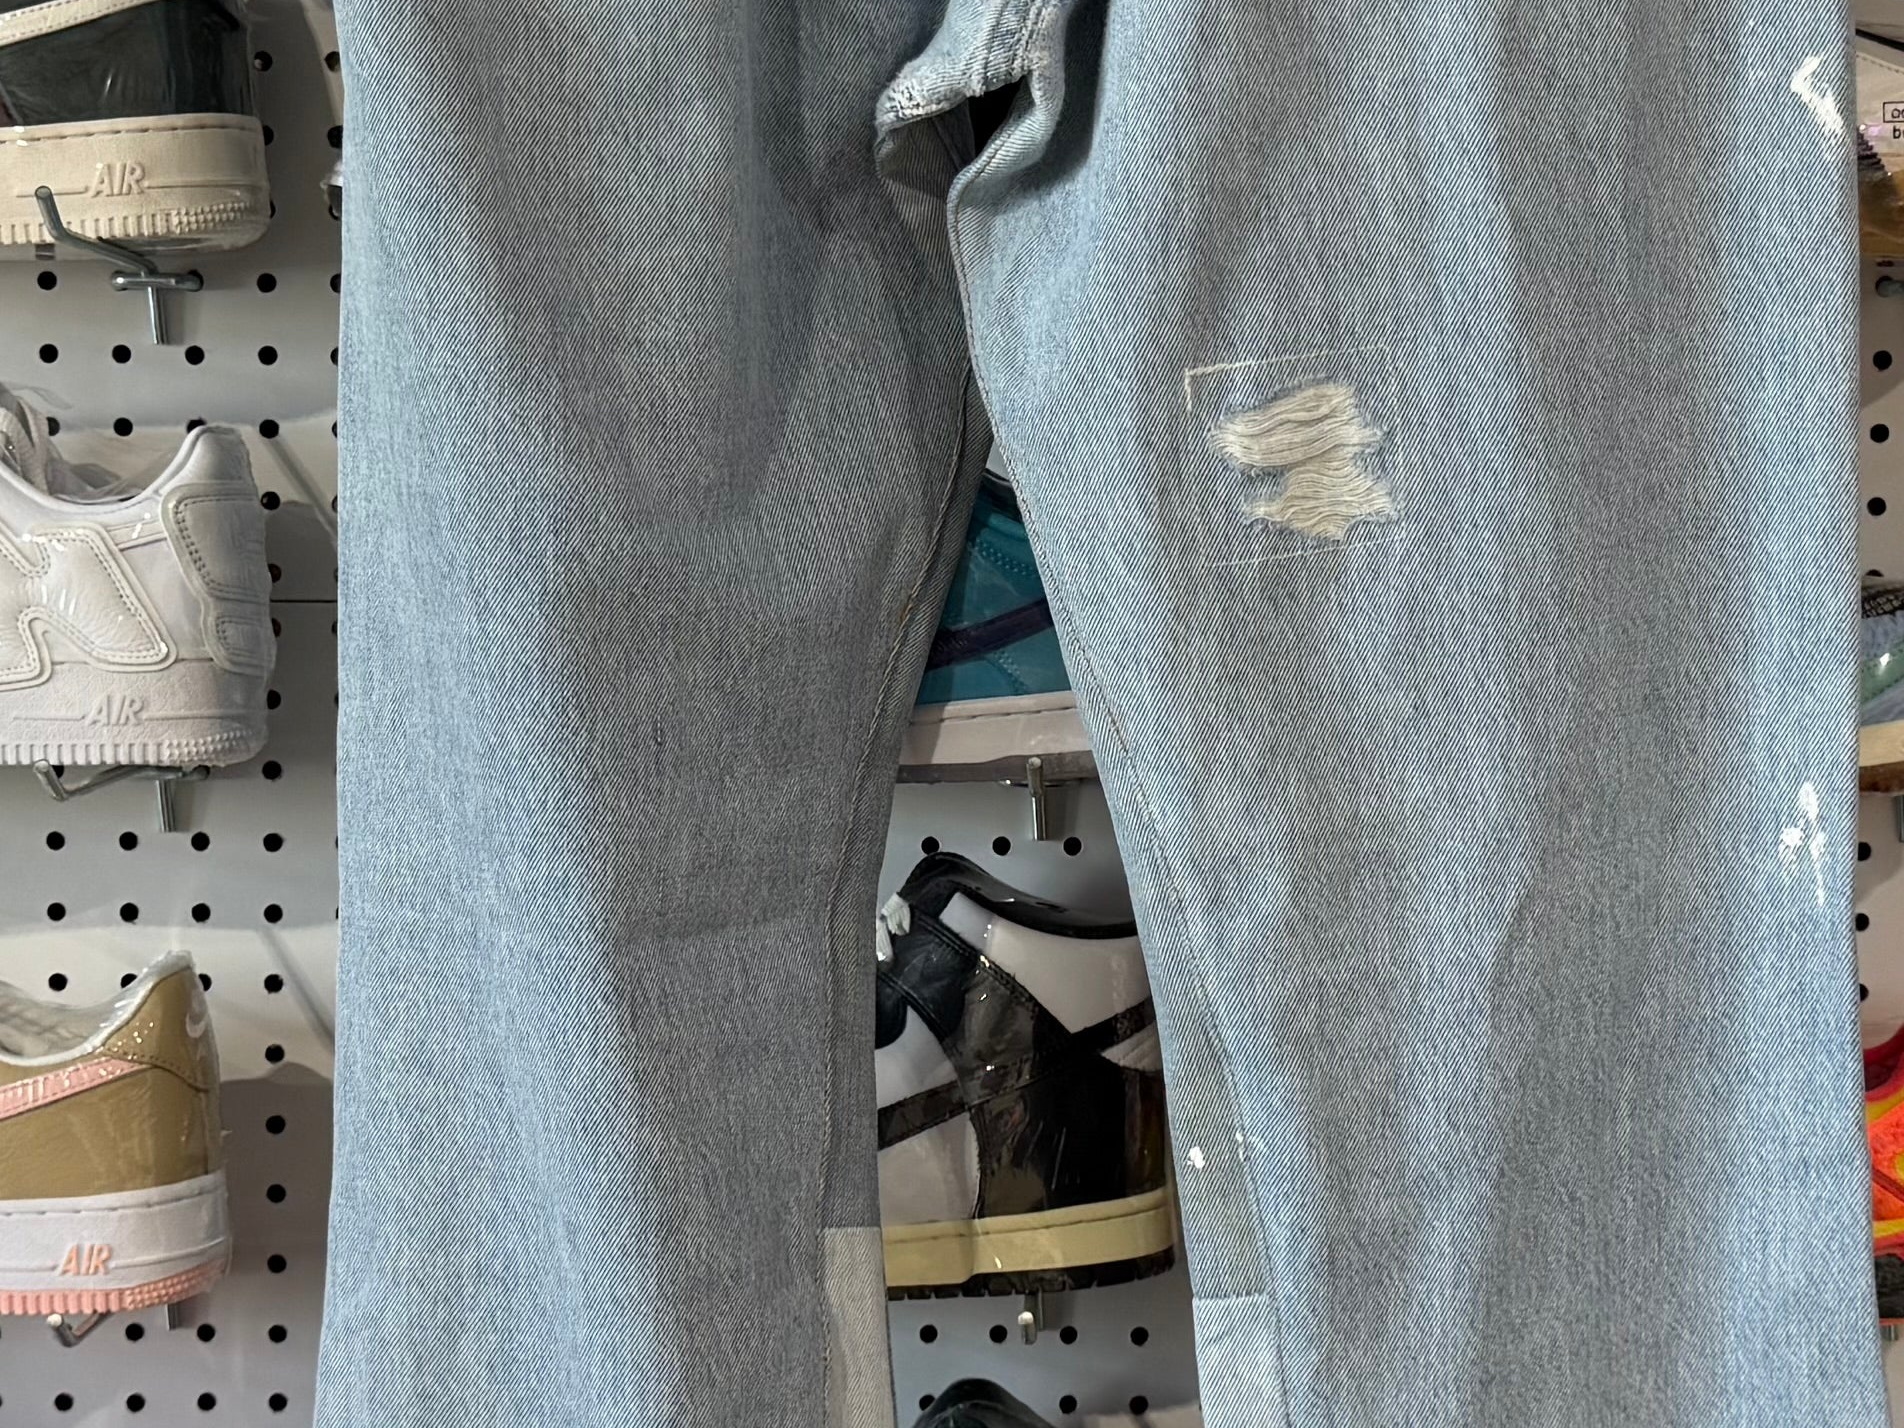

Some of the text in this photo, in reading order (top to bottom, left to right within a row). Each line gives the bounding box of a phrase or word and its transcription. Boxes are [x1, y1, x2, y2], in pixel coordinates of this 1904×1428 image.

[89, 160, 147, 198] AIR
[83, 692, 144, 727] AIR
[59, 1243, 114, 1277] AIR
